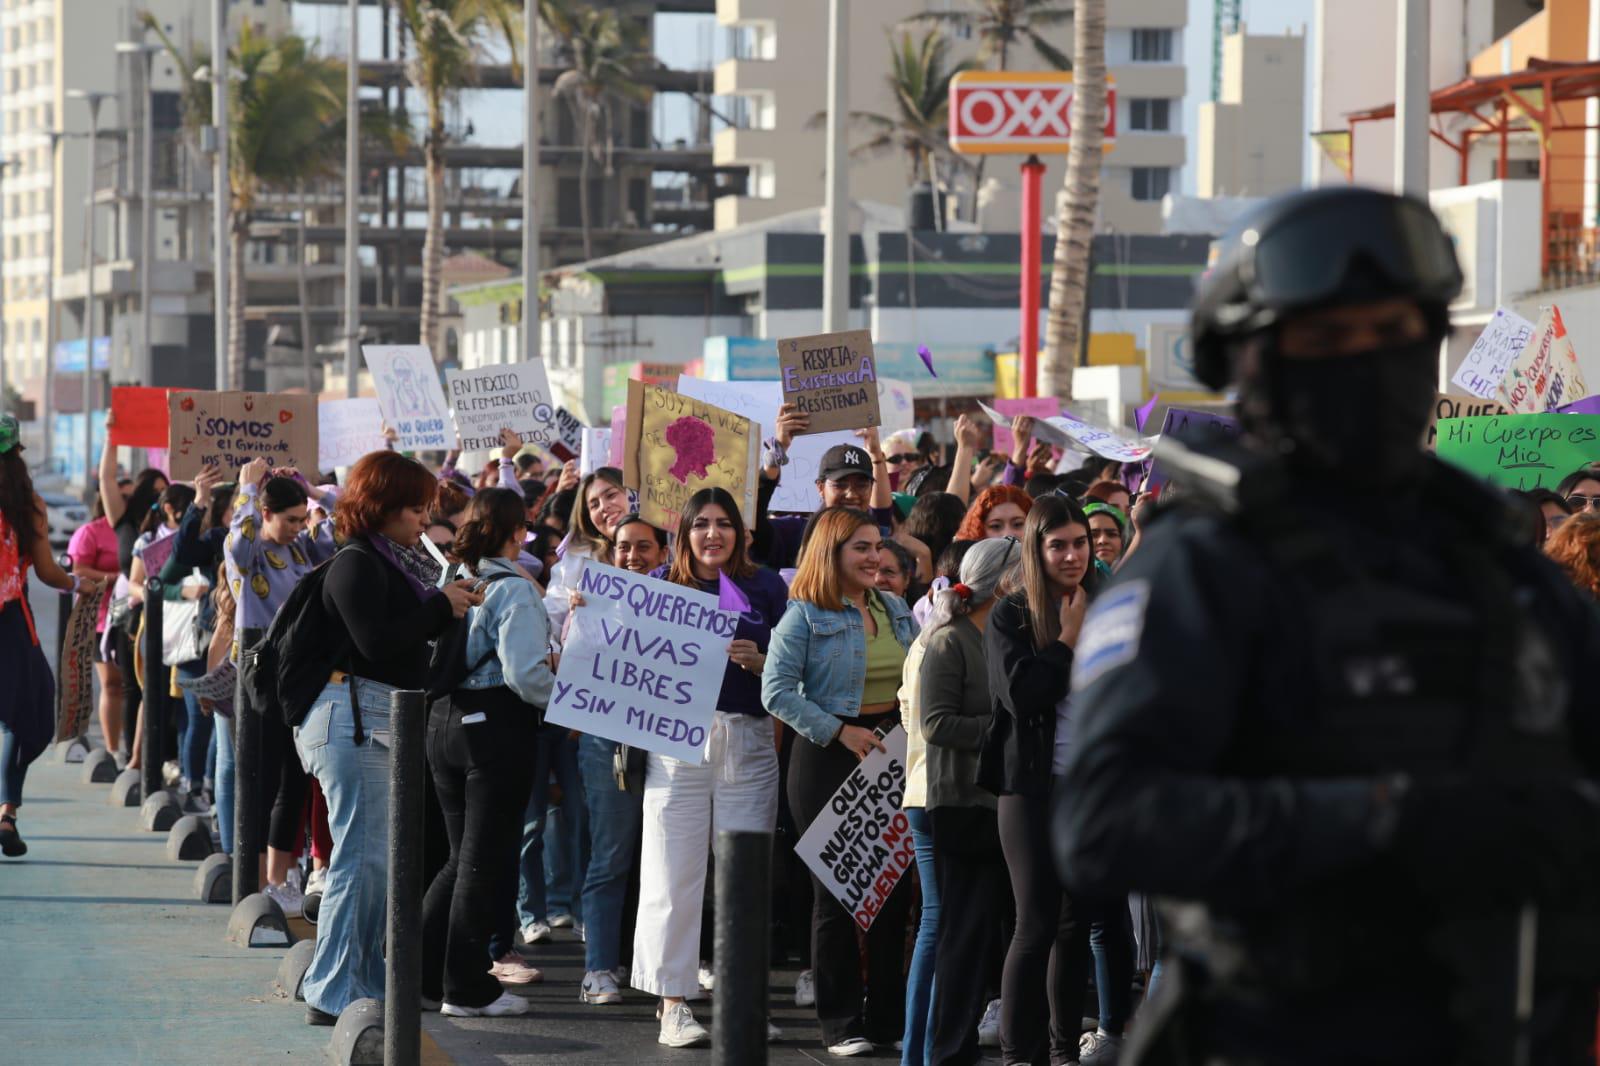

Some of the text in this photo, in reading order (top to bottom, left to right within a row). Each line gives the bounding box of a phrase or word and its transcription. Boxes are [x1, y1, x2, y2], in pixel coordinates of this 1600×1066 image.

[783, 356, 874, 393] EXISTENCIA
[802, 346, 851, 371] RESPETA
[452, 378, 471, 396] EN
[456, 389, 542, 411] EL FEMINISMO
[655, 387, 684, 414] SOY
[797, 388, 869, 412] RESISTENCIA
[398, 421, 412, 433] NO
[692, 401, 711, 424] LA
[401, 436, 413, 447] TU
[1449, 420, 1472, 443] Mi
[1483, 418, 1561, 447] Cuerpo
[1567, 426, 1597, 443] es
[581, 567, 738, 638] NOS QUEREMOS
[601, 618, 701, 666] VIVAS
[592, 652, 693, 704] LIBRES
[571, 688, 616, 714] SIN
[626, 706, 705, 747] MIEDO
[832, 768, 869, 816] QUE
[819, 759, 904, 869] NUESTROS
[833, 806, 890, 885] GRITOS
[841, 813, 909, 914] LUCHA NO
[854, 864, 900, 929] DEJEN
